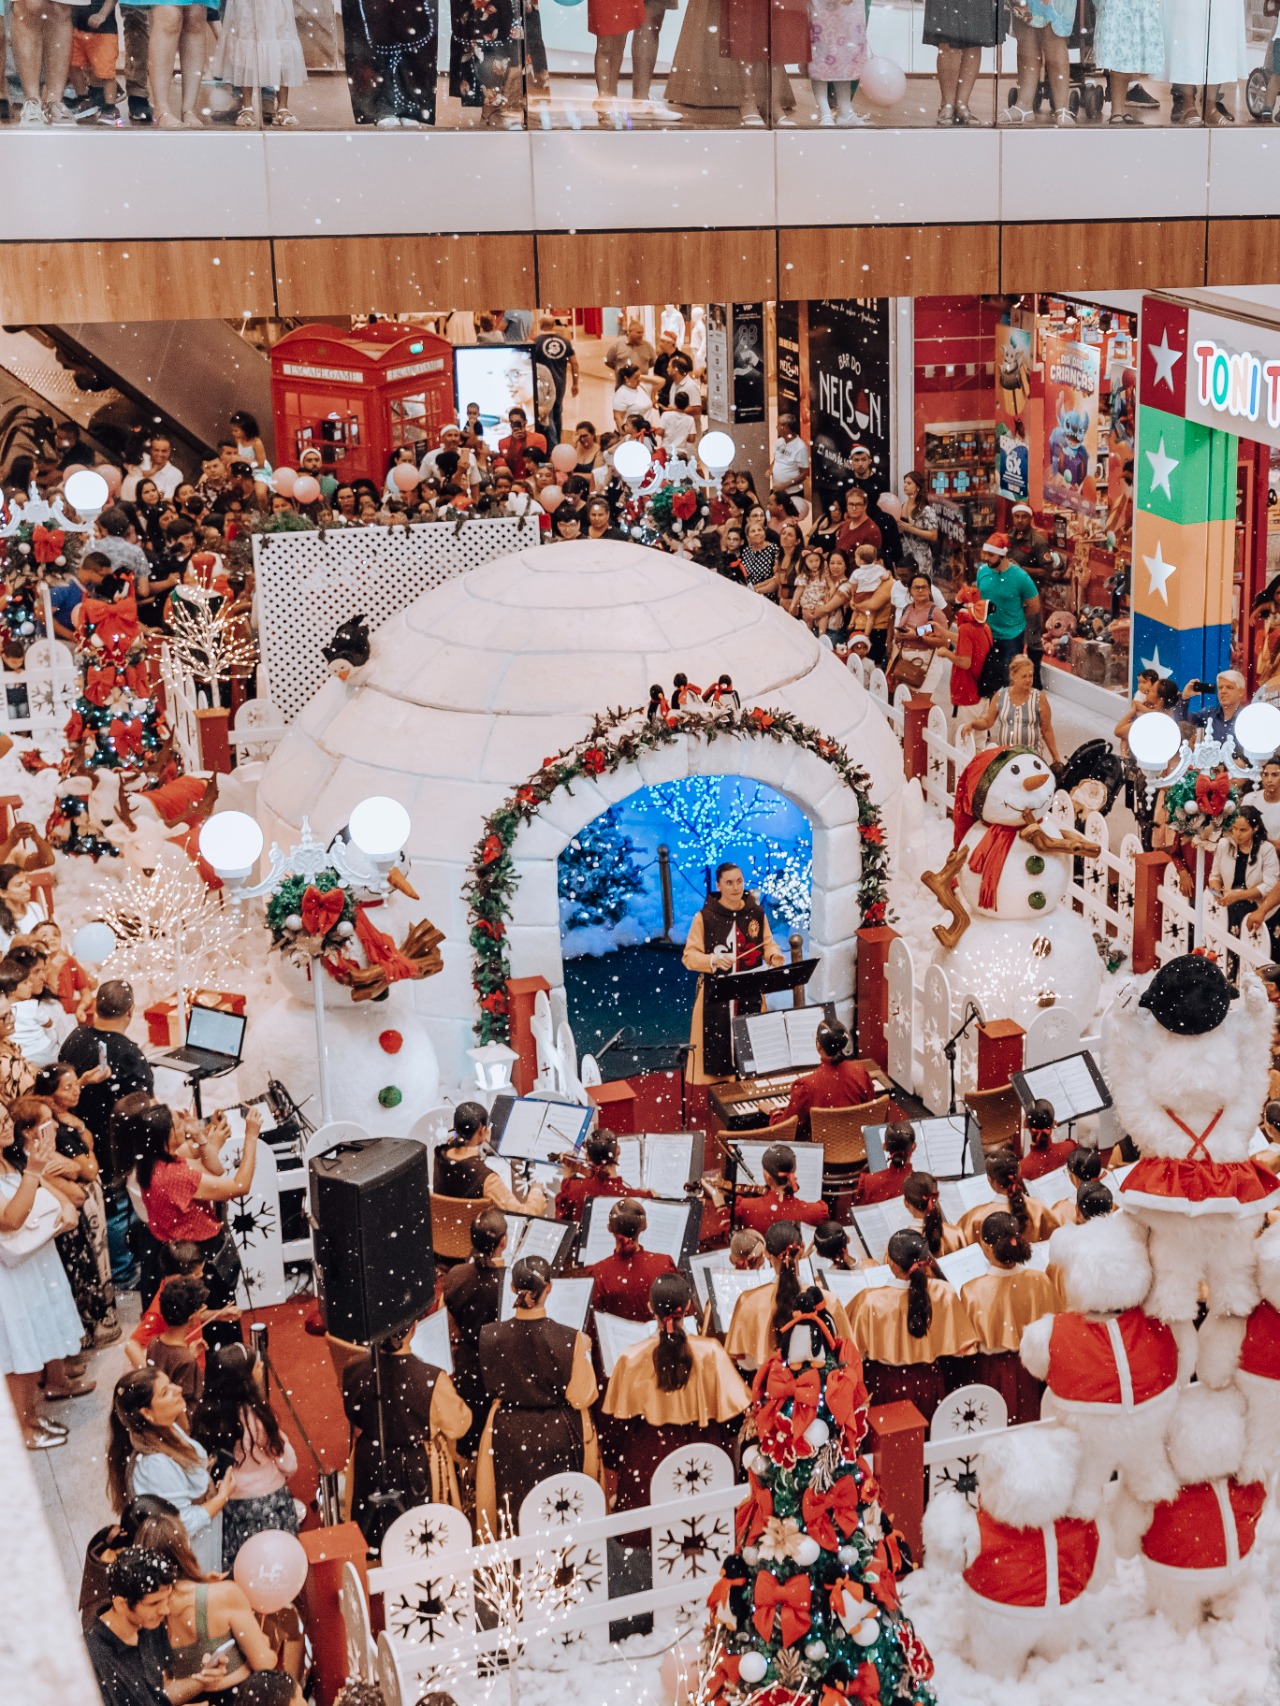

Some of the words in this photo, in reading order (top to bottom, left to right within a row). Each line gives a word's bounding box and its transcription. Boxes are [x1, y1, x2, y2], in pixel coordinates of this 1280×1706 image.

[838, 353, 850, 370] BAR
[851, 355, 861, 375] DO
[1050, 365, 1094, 392] CRIANÇAS
[1194, 342, 1260, 419] TONI
